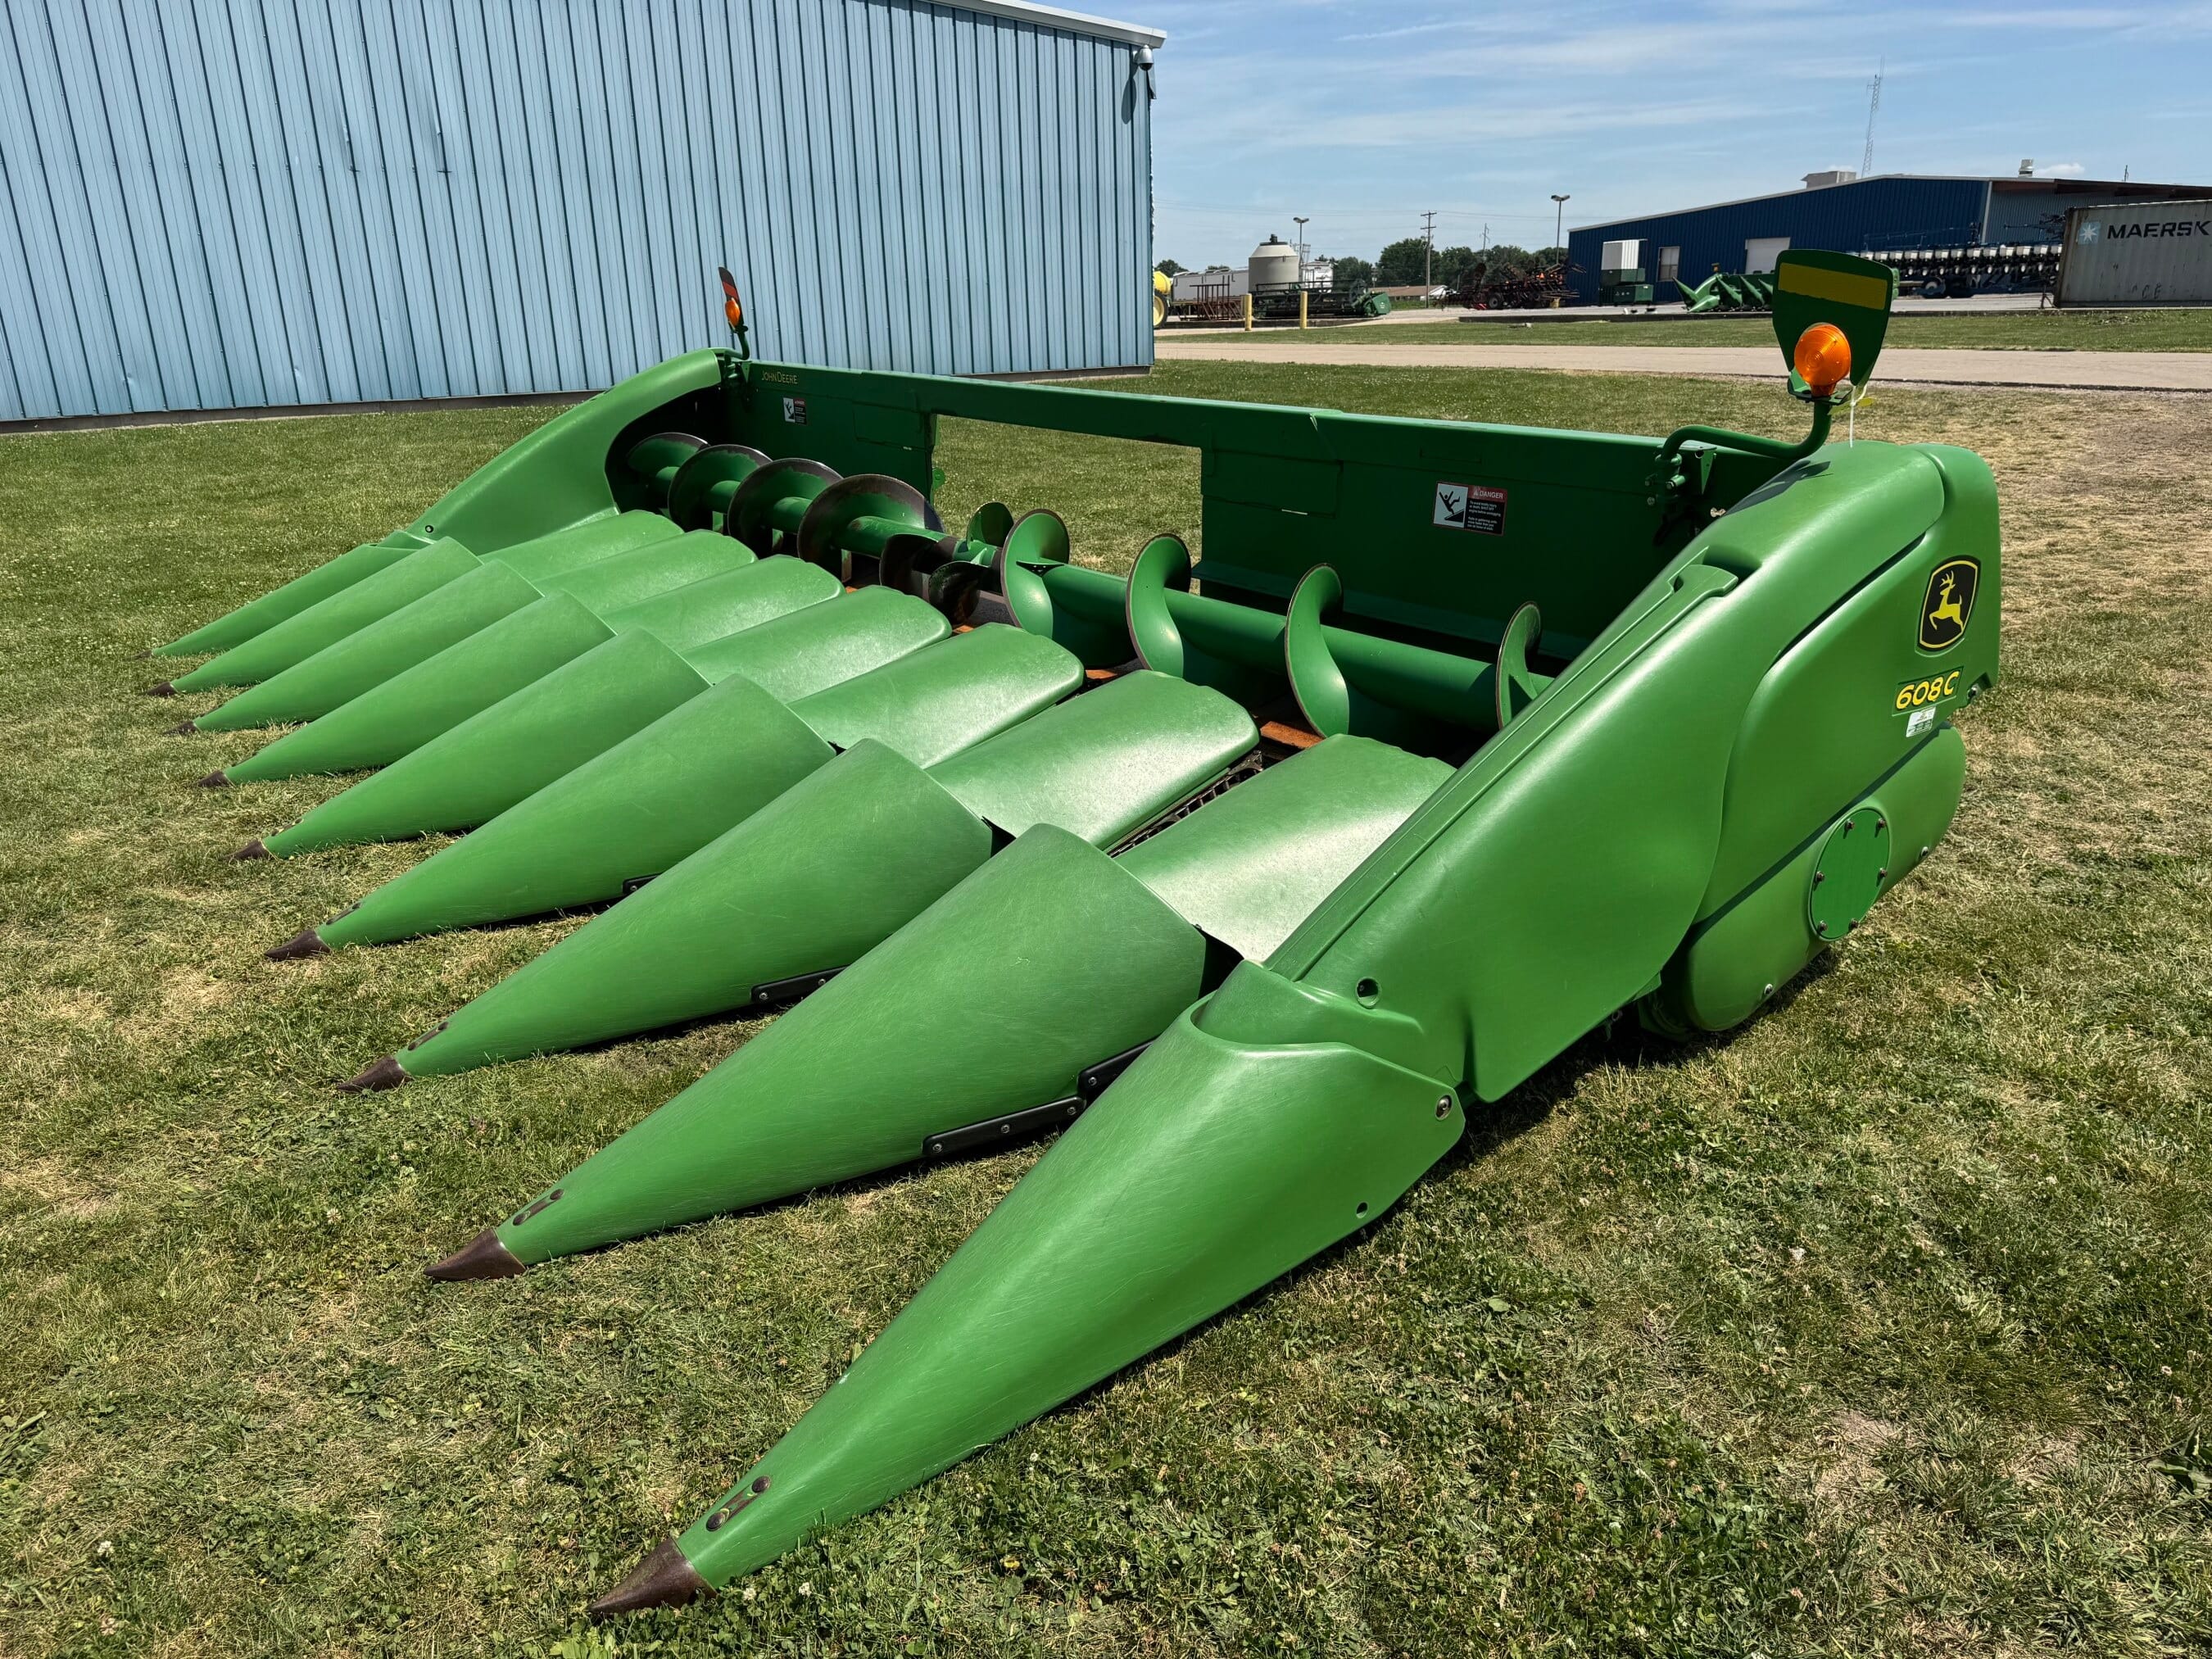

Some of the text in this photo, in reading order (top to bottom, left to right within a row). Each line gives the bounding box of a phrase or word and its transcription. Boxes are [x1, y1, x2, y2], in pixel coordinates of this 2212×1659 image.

[2107, 220, 2211, 240] MAERSK
[761, 369, 798, 384] JOHN DEERE
[1479, 490, 1503, 499] DANGER
[1896, 670, 1960, 709] 608C
